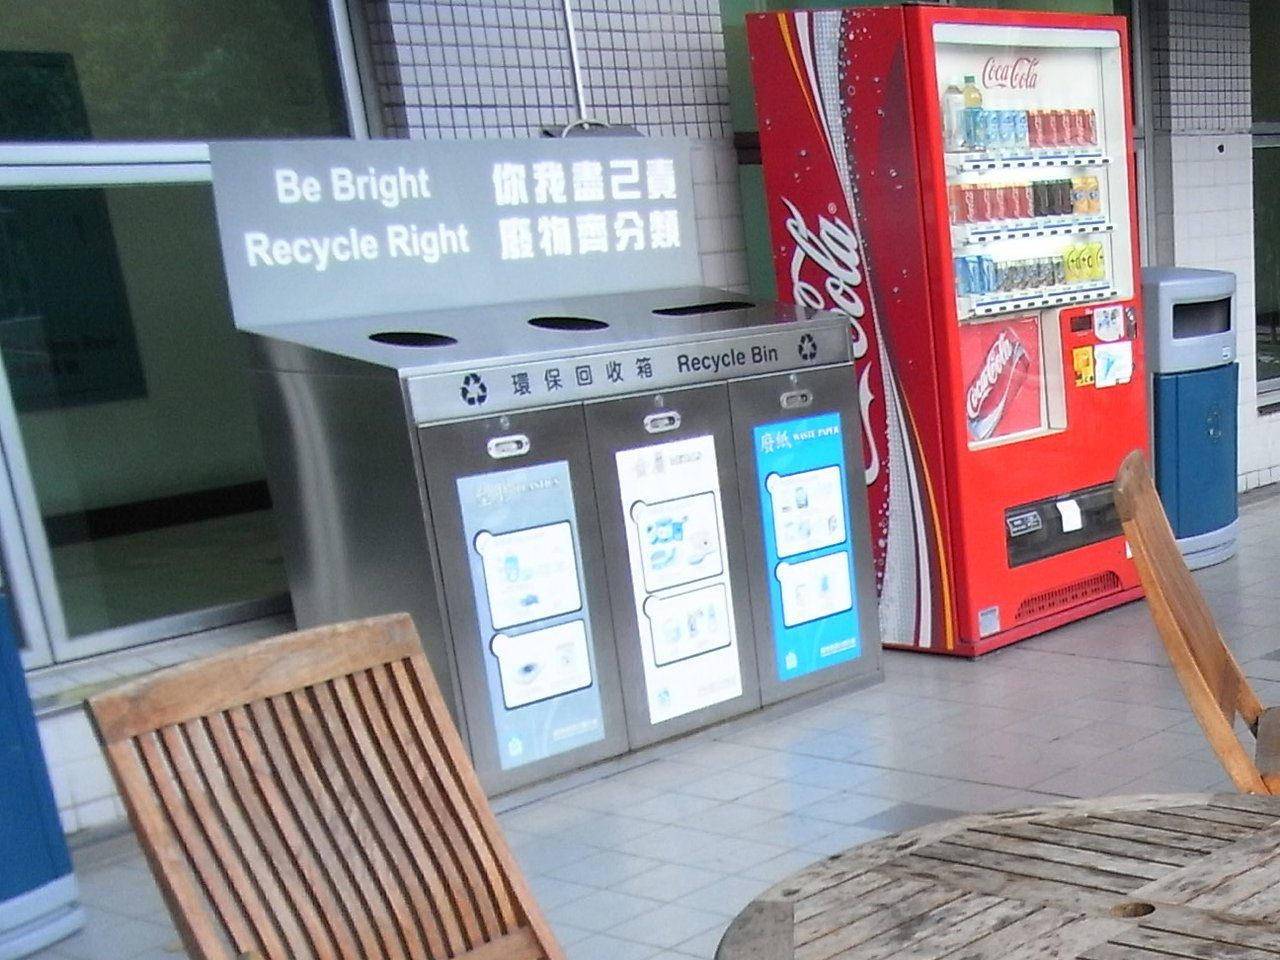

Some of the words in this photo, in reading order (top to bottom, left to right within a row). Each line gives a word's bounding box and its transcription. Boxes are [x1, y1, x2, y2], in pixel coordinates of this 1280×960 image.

[275, 168, 322, 204] Be
[330, 166, 432, 208] Bright
[244, 227, 379, 272] Recycle
[386, 223, 470, 264] Right
[511, 357, 655, 397] 環保回收箱
[676, 348, 746, 374] Recycle
[752, 345, 778, 364] Bin
